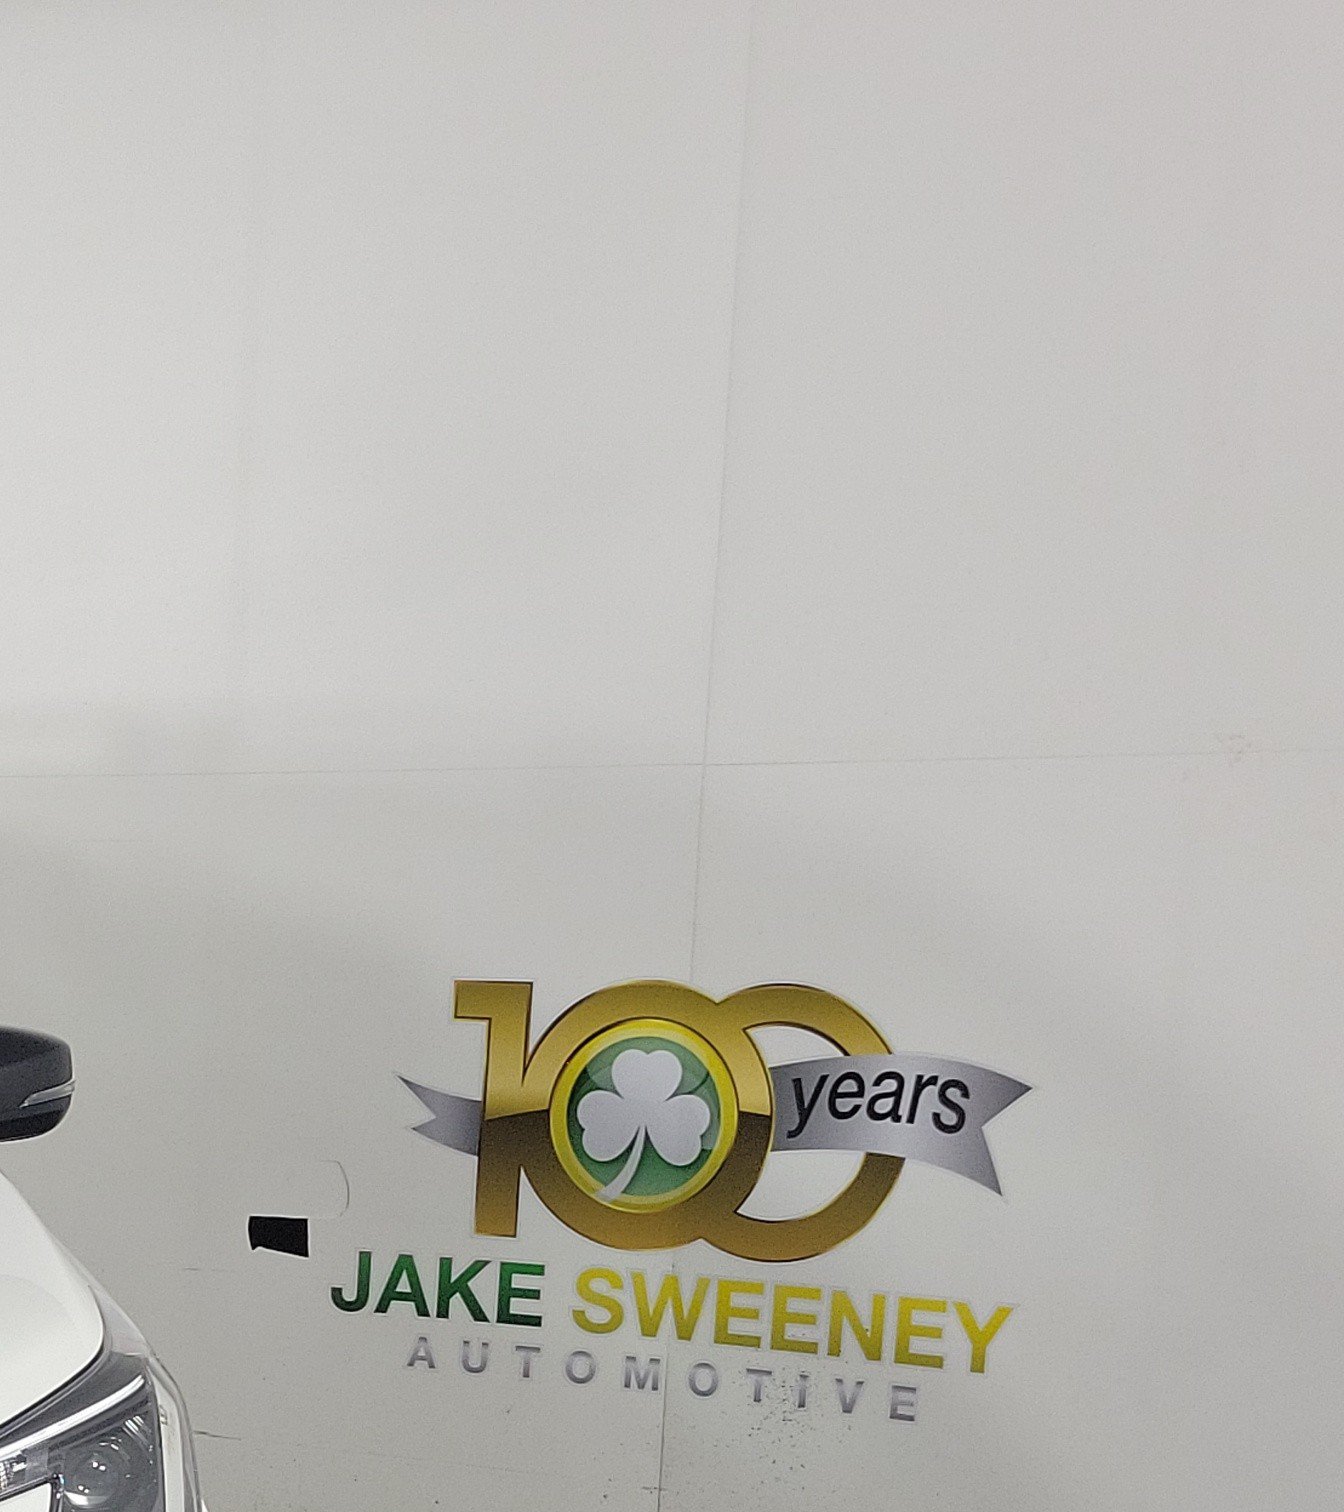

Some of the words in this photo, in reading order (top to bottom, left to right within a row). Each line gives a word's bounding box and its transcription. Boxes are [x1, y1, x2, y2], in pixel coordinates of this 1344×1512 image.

[453, 978, 907, 1264] 100
[787, 1067, 971, 1138] years
[330, 1250, 546, 1328] JAKE
[571, 1266, 1013, 1375] SWEENEY
[406, 1336, 919, 1423] AUTOMOTIVE
